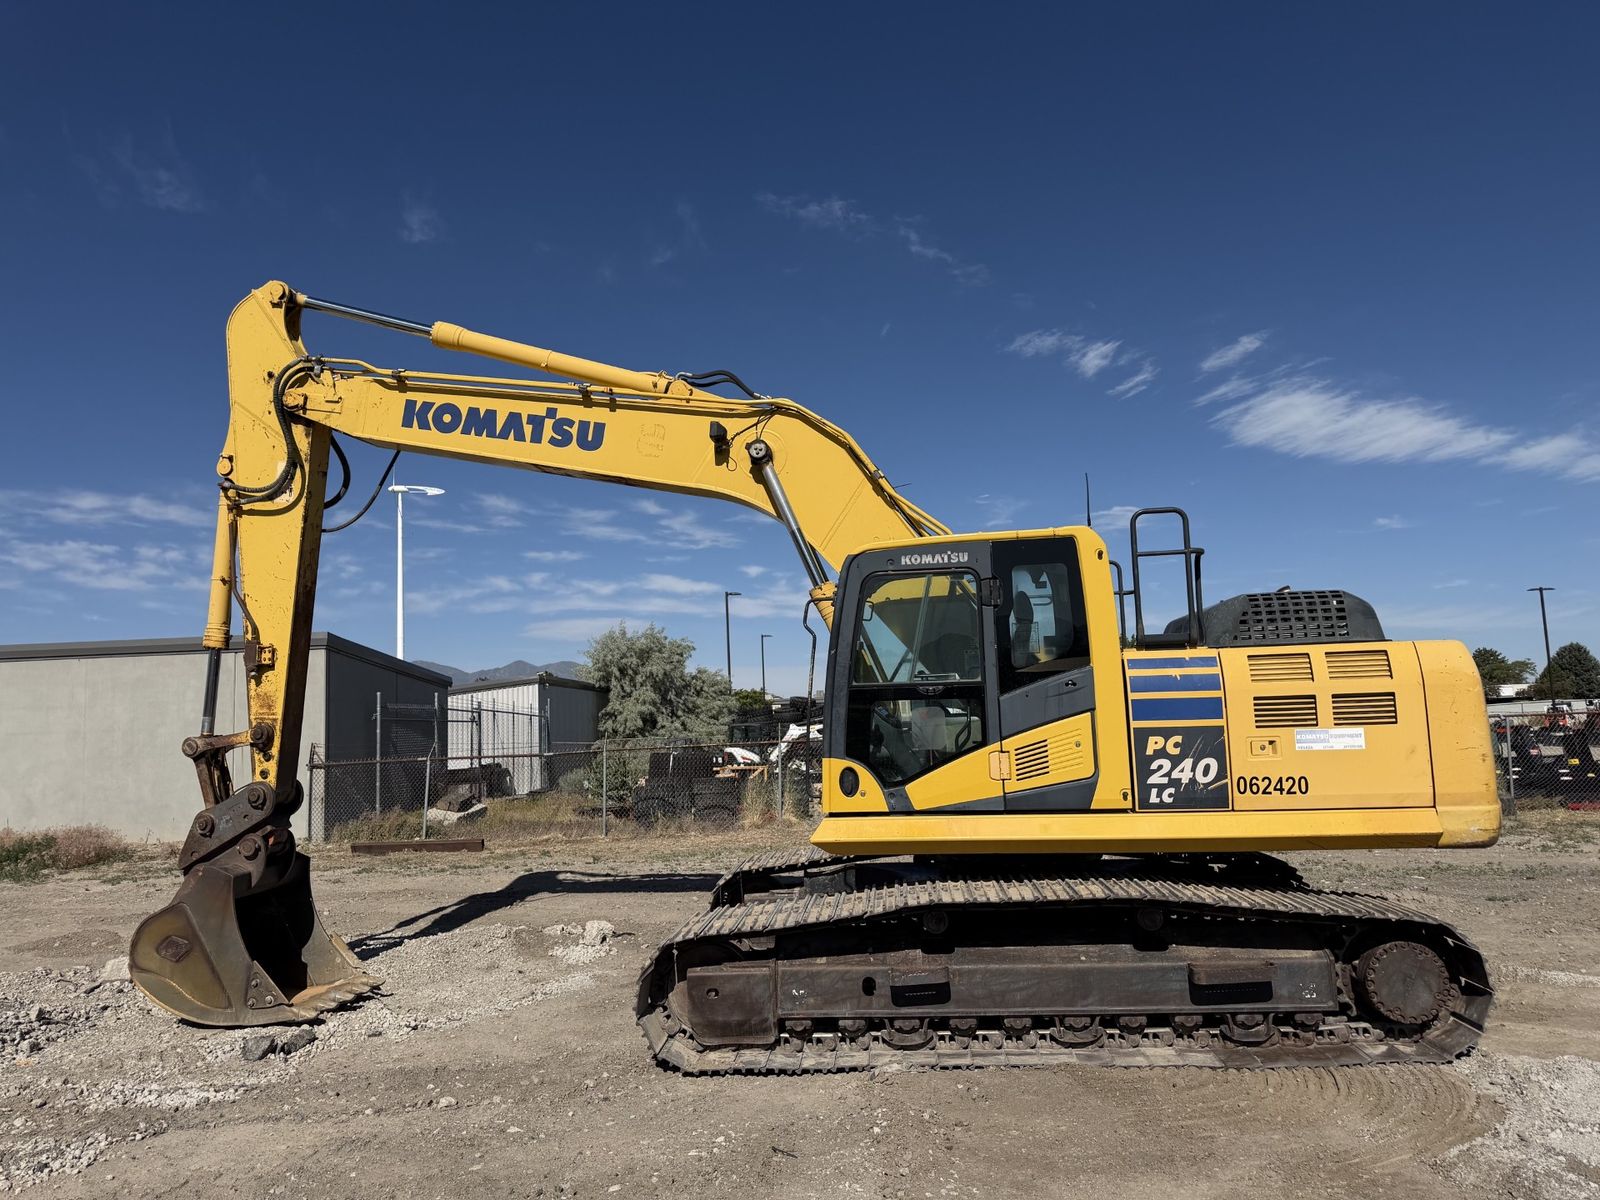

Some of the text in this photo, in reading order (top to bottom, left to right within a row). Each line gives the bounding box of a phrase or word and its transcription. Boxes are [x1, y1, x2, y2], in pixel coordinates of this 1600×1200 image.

[401, 399, 606, 451] KOMATSU
[901, 551, 968, 565] KOMATSU
[1146, 736, 1183, 755] PC
[1147, 757, 1218, 784] 240
[1236, 776, 1309, 795] 062420
[1149, 788, 1175, 803] LC
